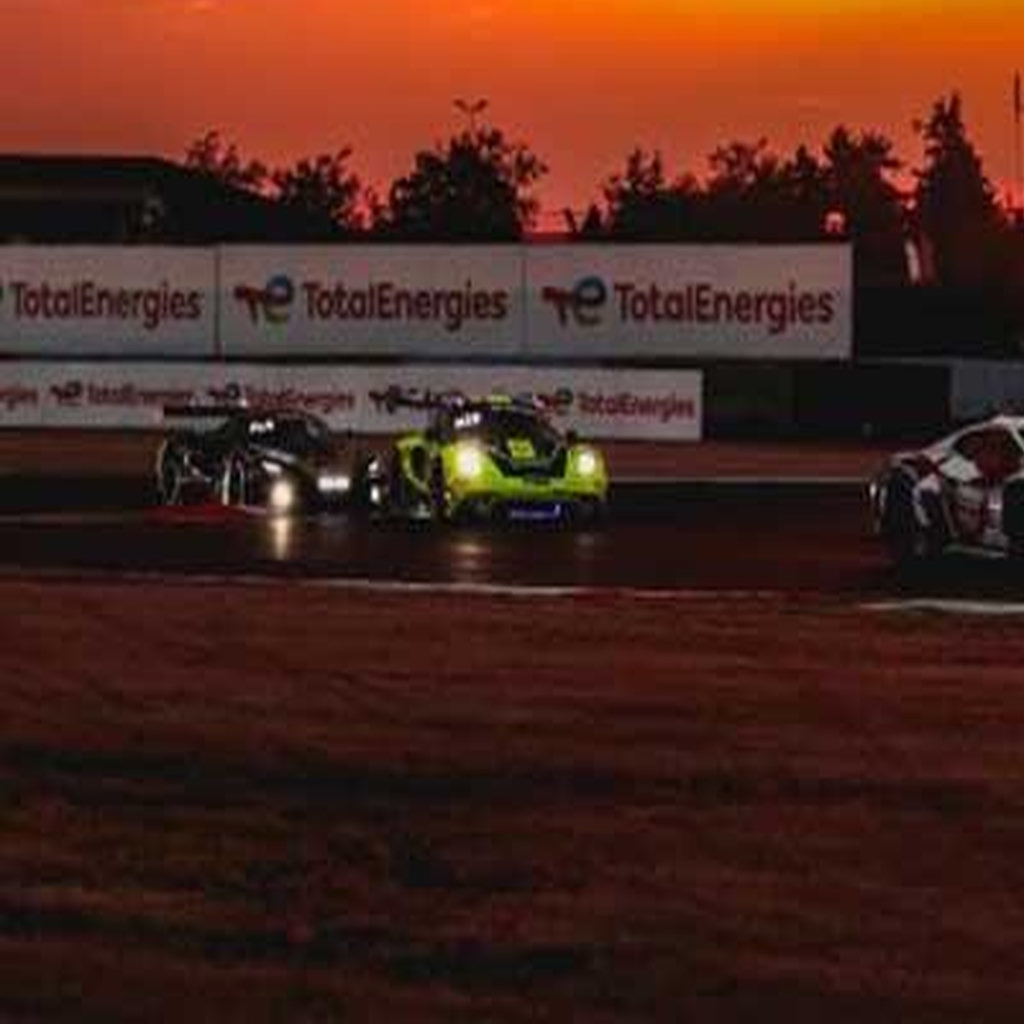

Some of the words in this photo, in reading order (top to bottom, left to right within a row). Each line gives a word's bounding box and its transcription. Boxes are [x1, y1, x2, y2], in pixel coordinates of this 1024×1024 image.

[13, 280, 203, 330] TotalEnergies
[303, 280, 508, 332] TotalEnergies
[614, 279, 834, 334] TotalEnergies
